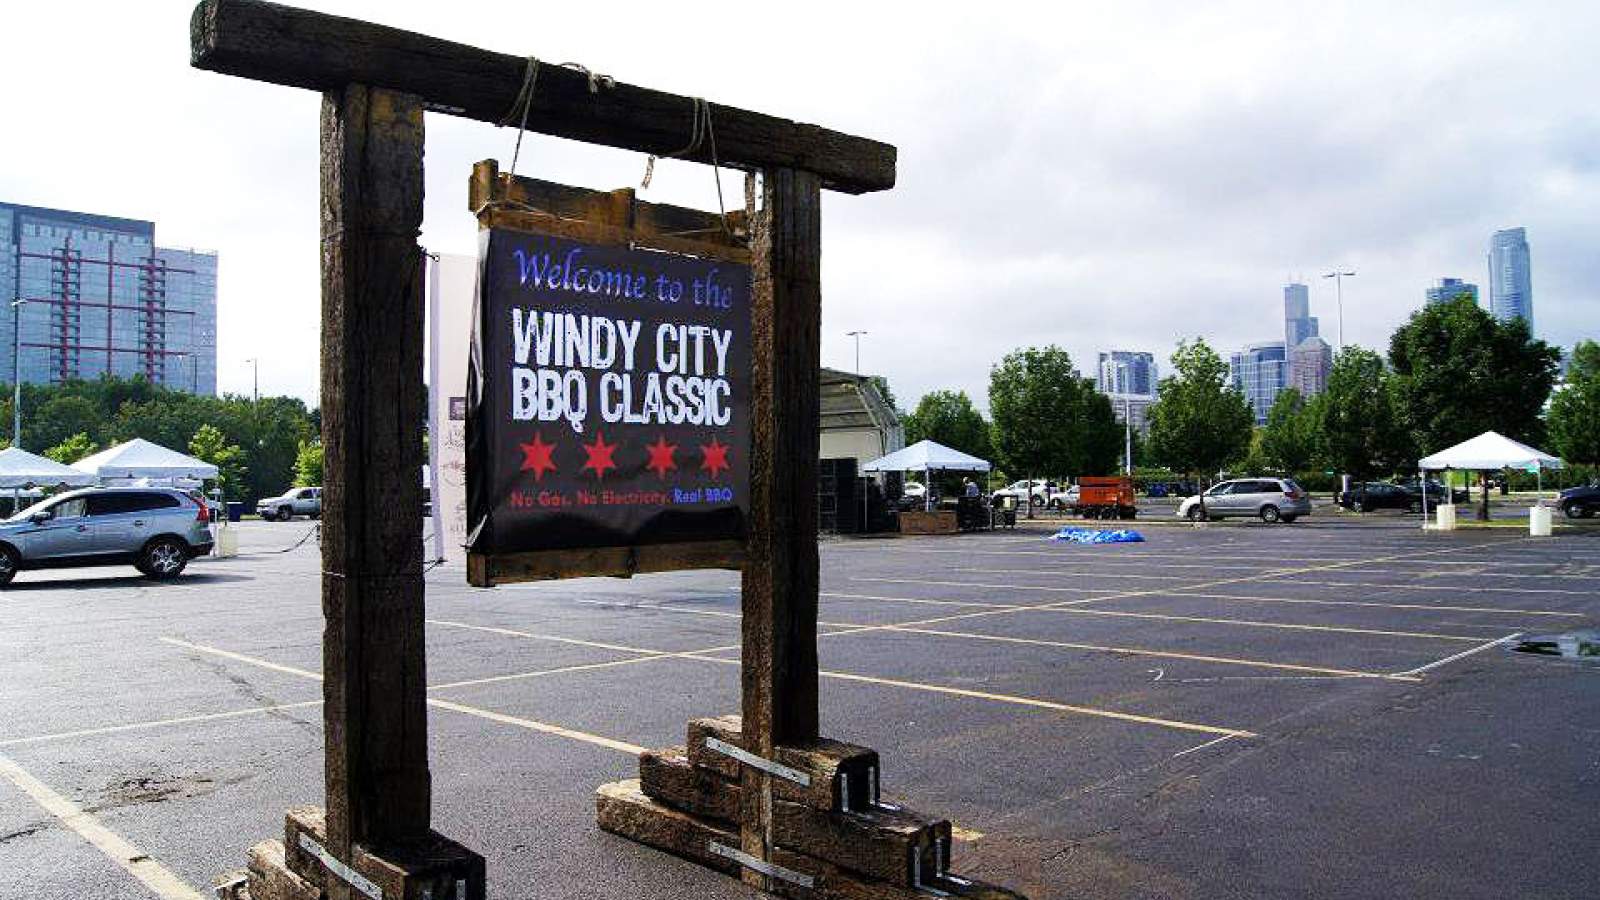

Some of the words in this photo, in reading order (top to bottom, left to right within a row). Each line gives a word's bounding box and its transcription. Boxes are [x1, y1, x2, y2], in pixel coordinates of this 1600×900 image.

[513, 249, 646, 298] Welcome
[656, 274, 683, 302] to
[693, 269, 733, 309] the
[512, 308, 641, 370] WINDY
[656, 323, 732, 376] CITY
[512, 368, 588, 433] BBQ
[600, 372, 731, 426] CLASSIC
[511, 490, 533, 507] No
[577, 490, 598, 505] No
[673, 487, 700, 504] Real
[704, 486, 733, 503] BBQ
